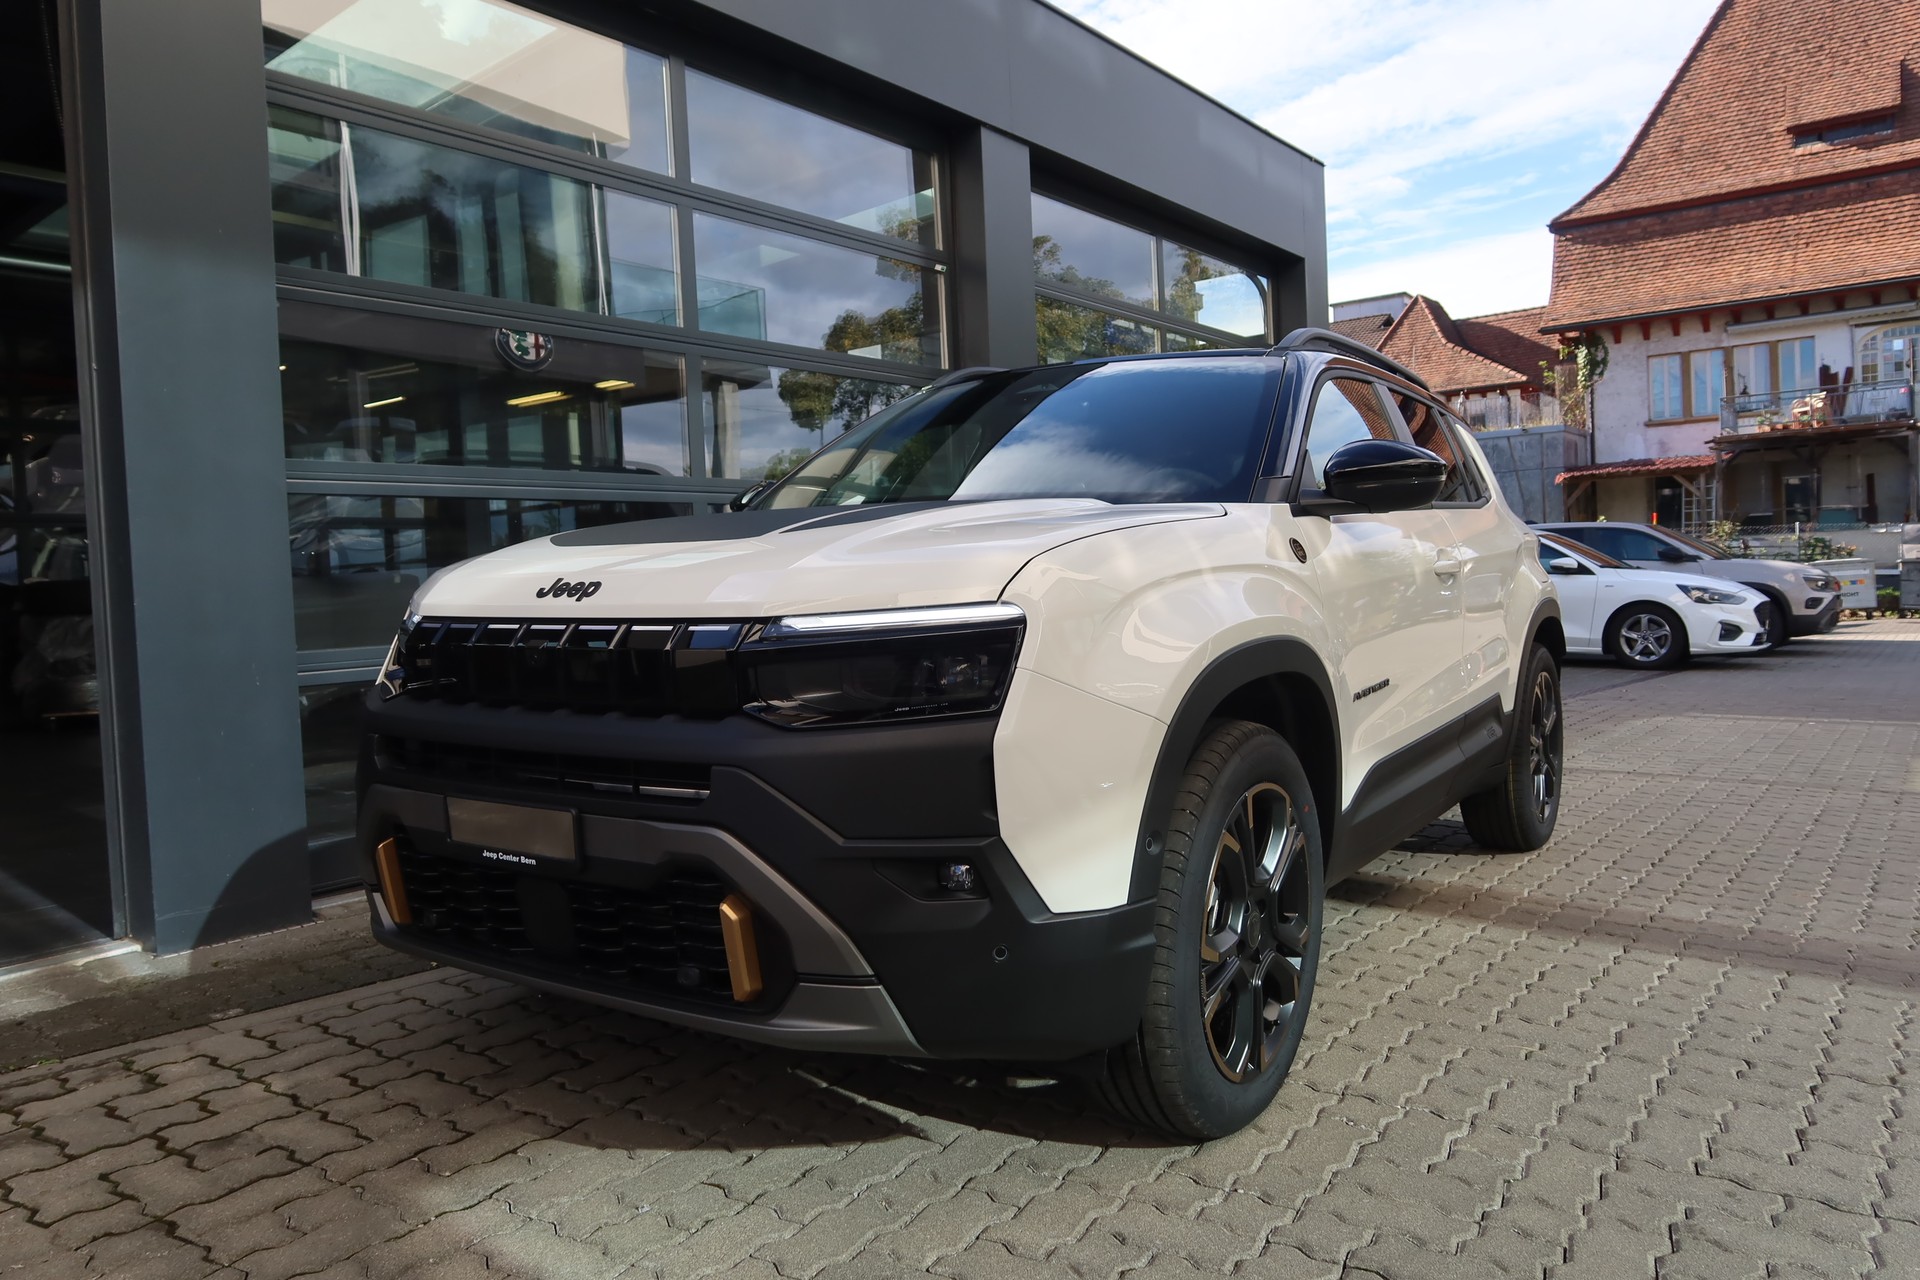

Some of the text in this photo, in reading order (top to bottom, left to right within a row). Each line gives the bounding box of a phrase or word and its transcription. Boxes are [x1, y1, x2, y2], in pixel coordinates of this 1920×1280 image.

[536, 577, 602, 602] Jeep
[482, 849, 537, 866] Jeep Center Bern
